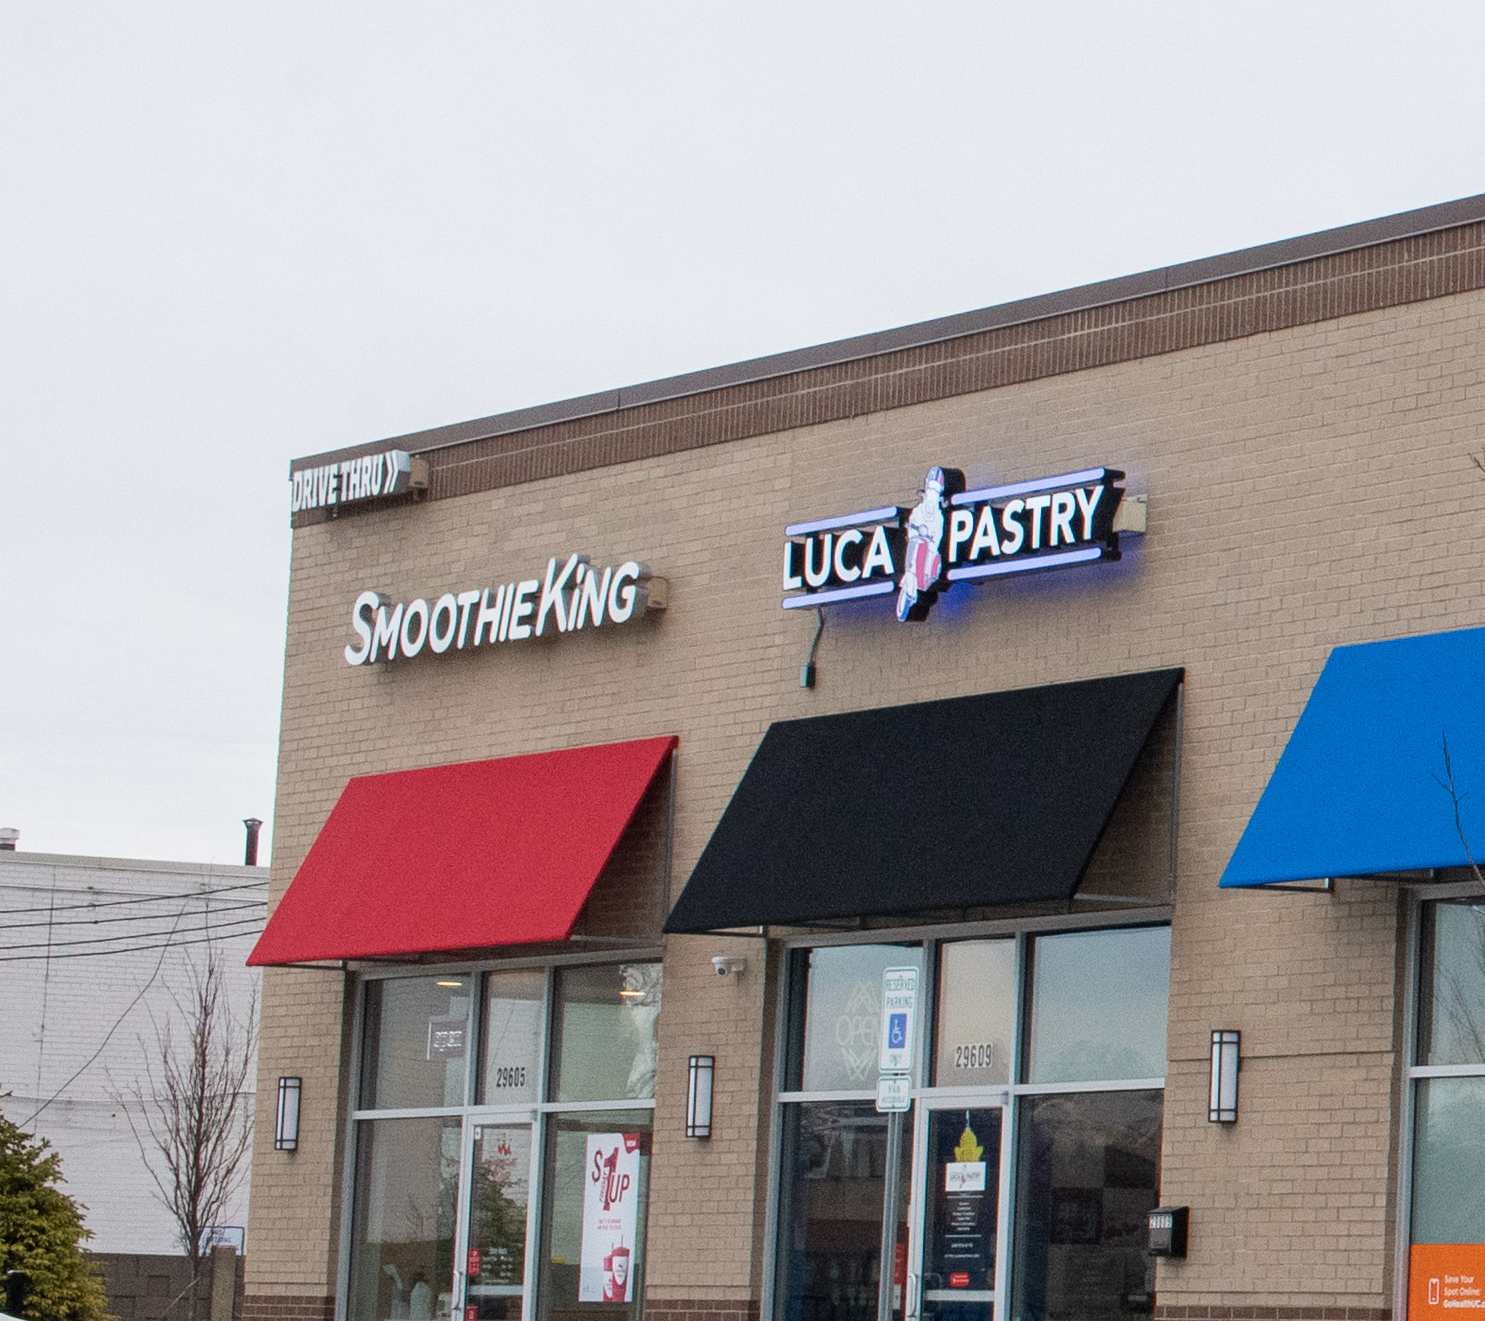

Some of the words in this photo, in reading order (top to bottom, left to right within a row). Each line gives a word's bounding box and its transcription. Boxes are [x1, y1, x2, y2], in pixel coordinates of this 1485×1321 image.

[291, 463, 339, 512] DRIVE
[339, 453, 385, 503] THRU
[782, 526, 895, 591] LUCA
[948, 485, 1105, 563] PASTRY
[886, 997, 912, 1009] PARKING
[955, 1044, 993, 1068] 29609
[496, 1067, 526, 1088] 29605
[609, 1174, 630, 1203] UP
[1444, 1275, 1459, 1284] Save
[1460, 1275, 1475, 1284] Your
